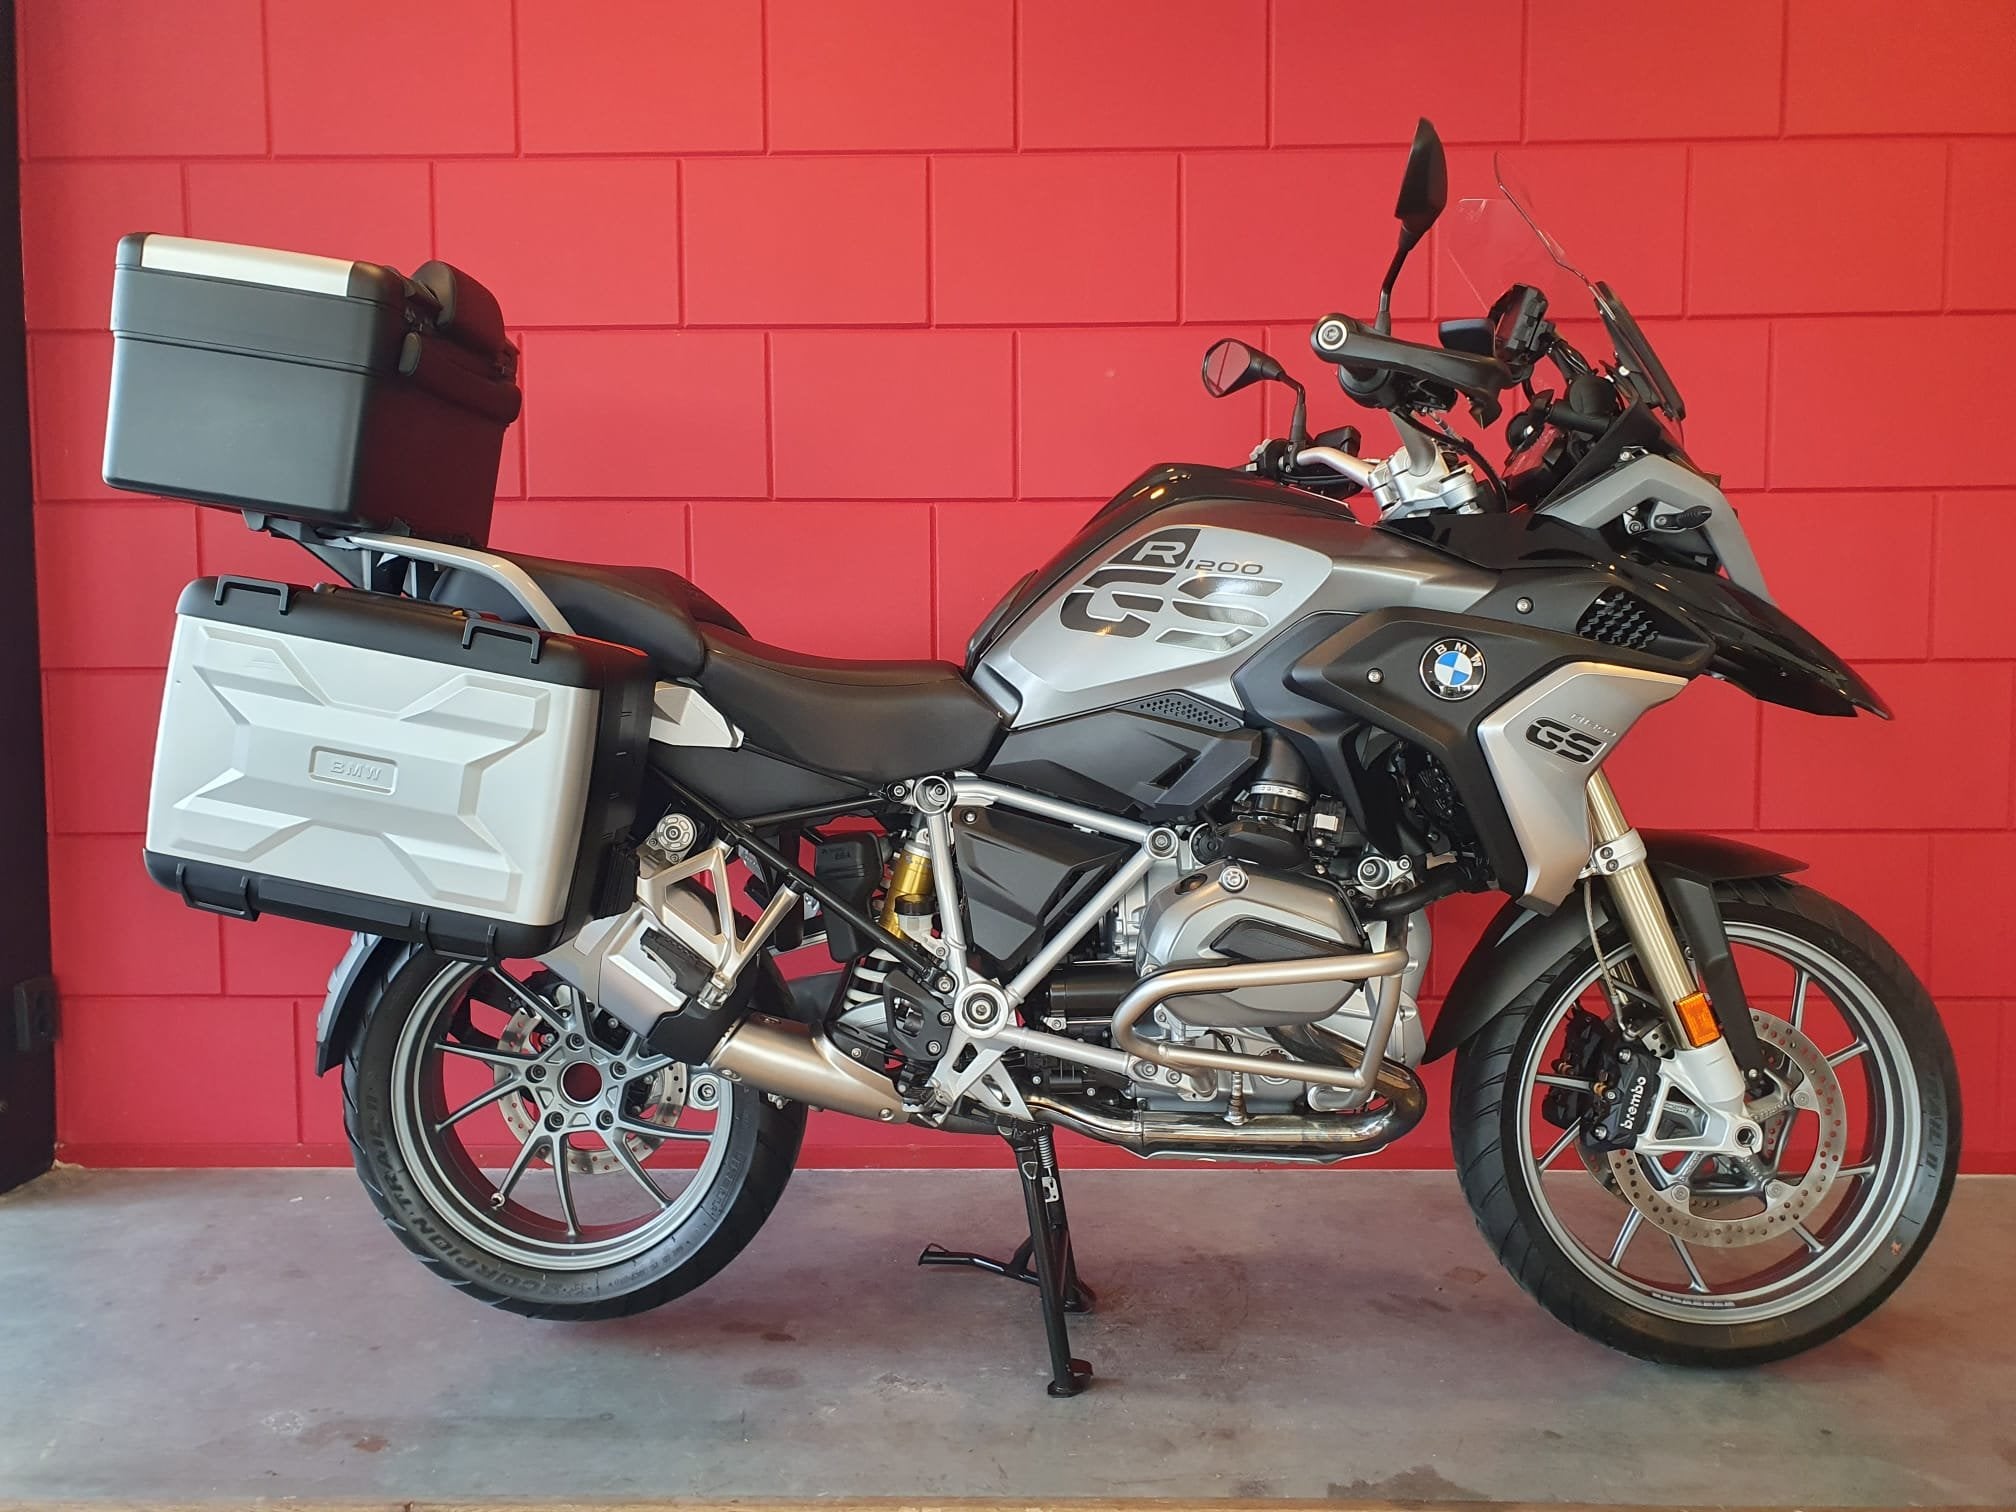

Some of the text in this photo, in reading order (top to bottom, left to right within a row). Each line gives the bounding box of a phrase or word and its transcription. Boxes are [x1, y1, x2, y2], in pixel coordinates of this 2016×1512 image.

[1132, 541, 1264, 575] R 1200
[1060, 566, 1283, 653] GS
[1434, 641, 1483, 667] BMW
[1525, 718, 1603, 763] GS
[330, 761, 382, 780] BMW
[1620, 1076, 1647, 1130] brembo
